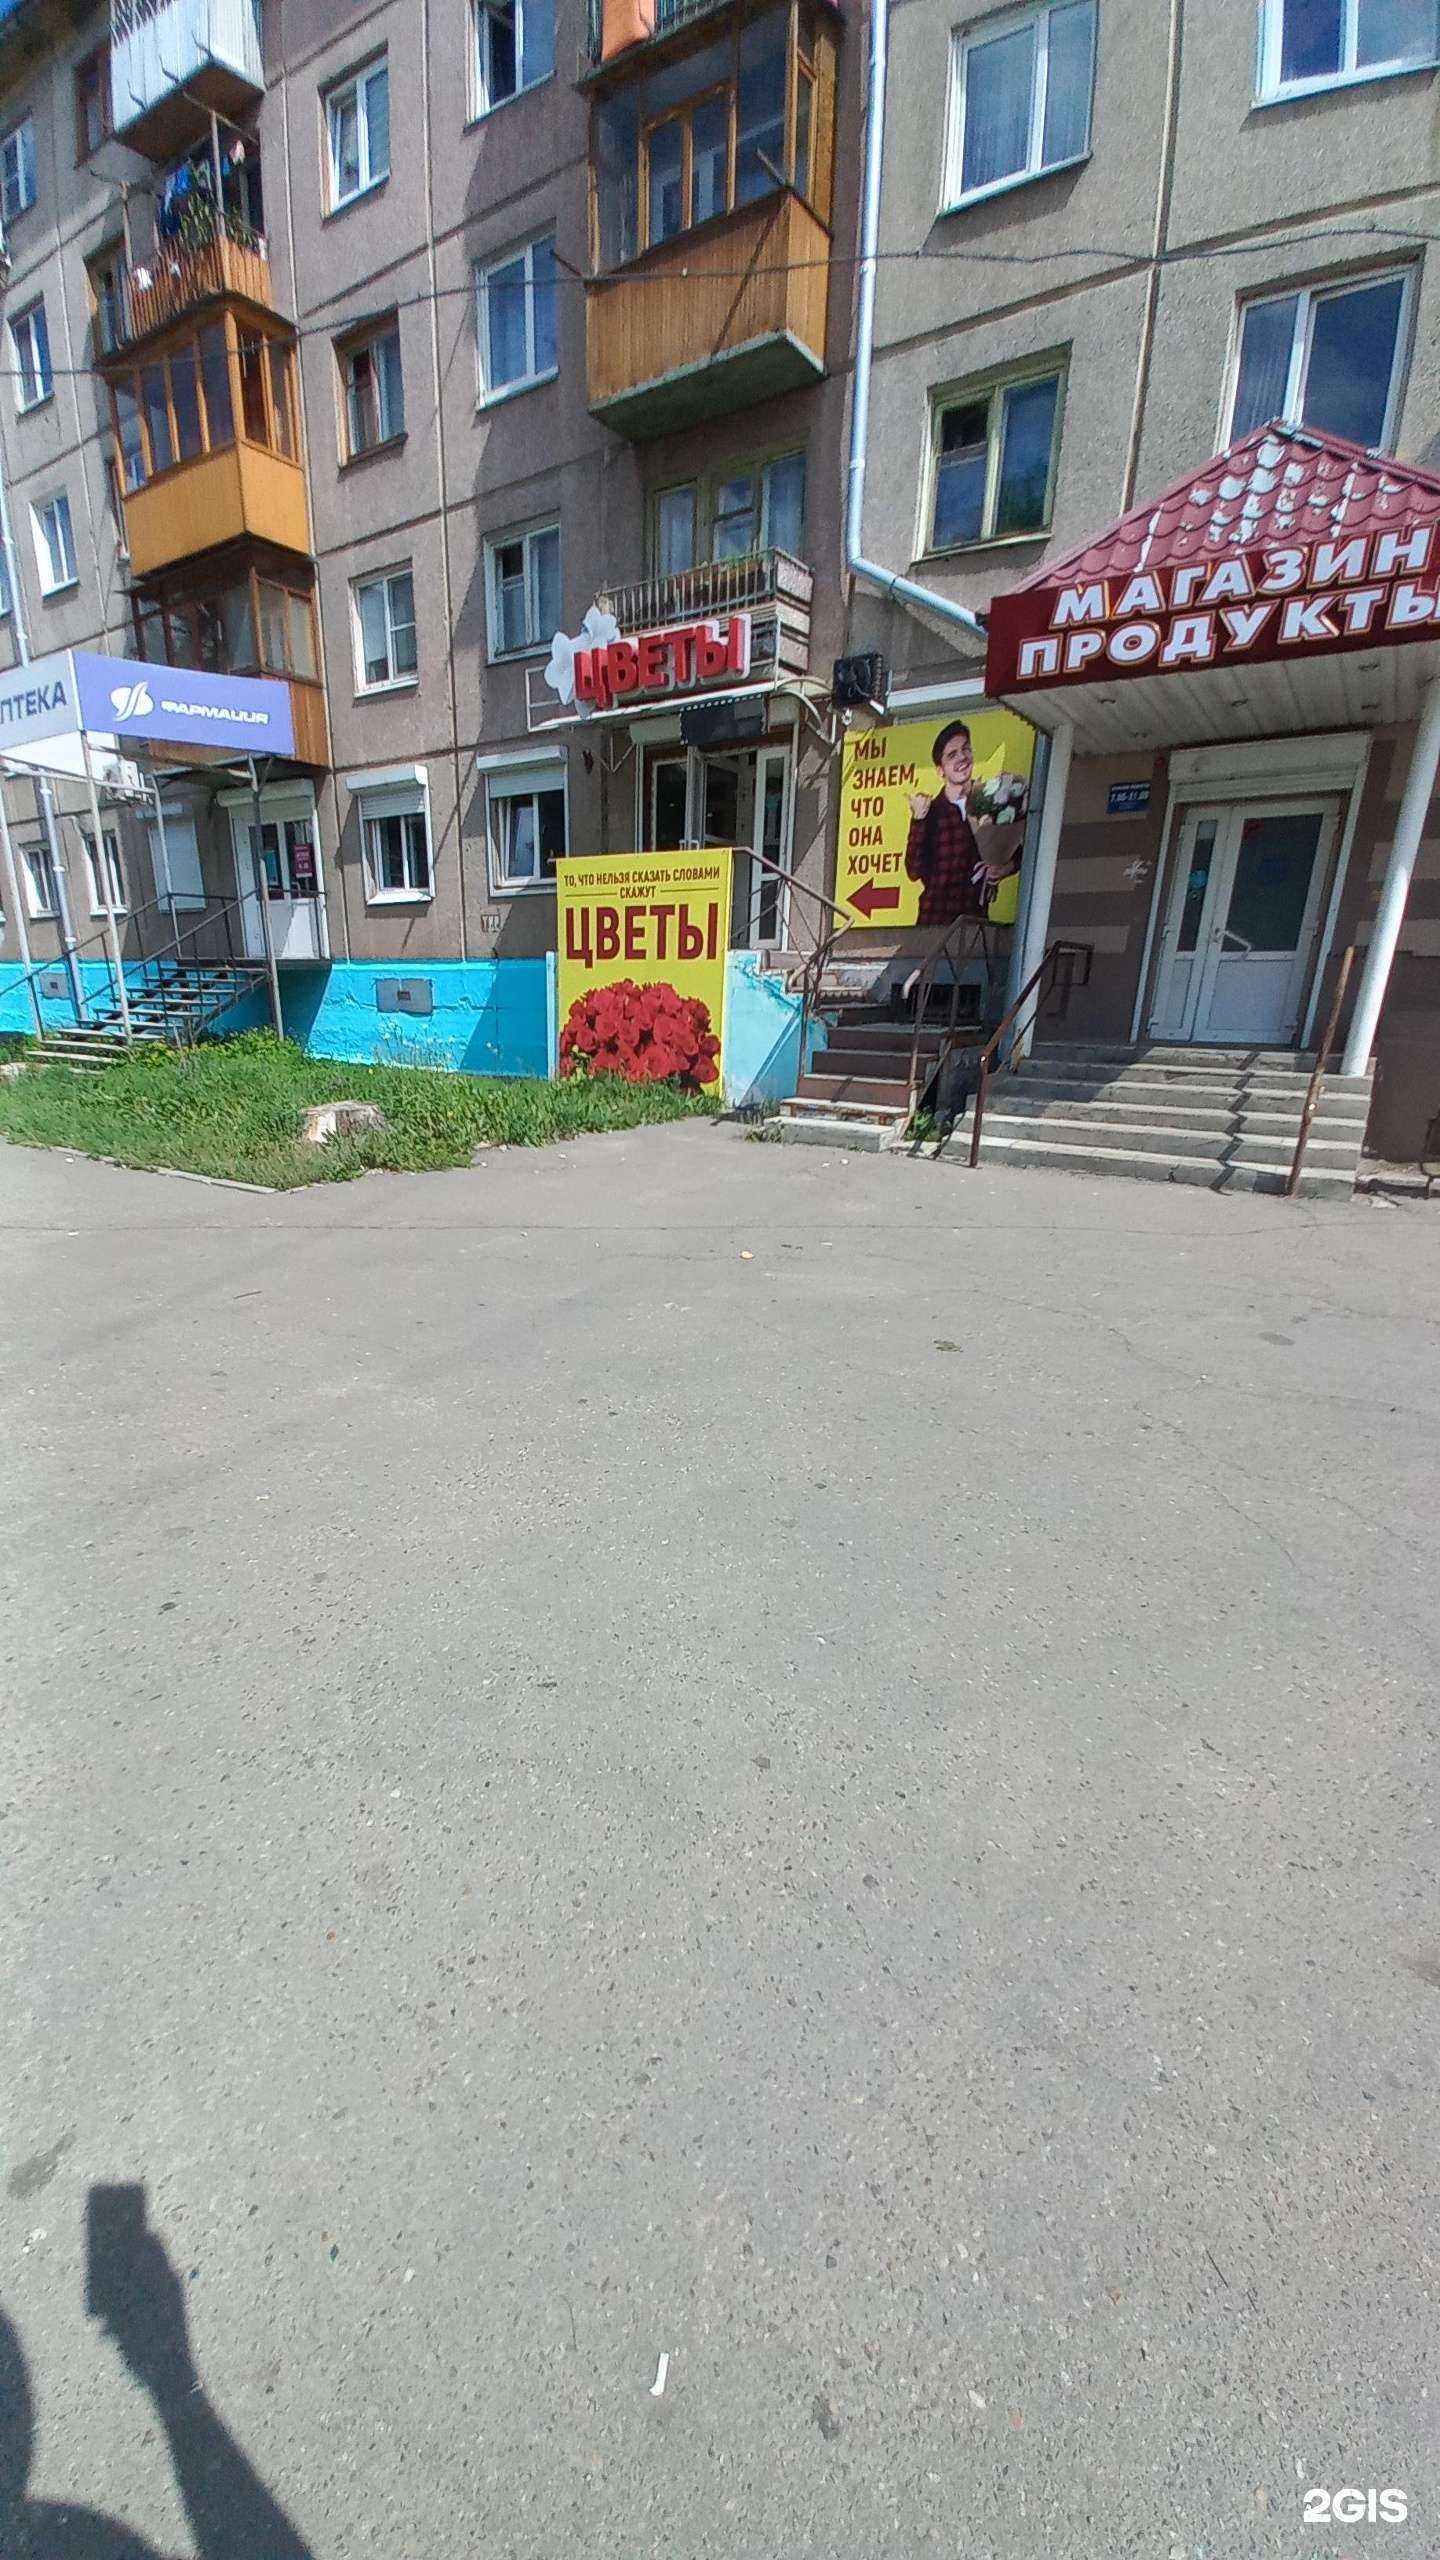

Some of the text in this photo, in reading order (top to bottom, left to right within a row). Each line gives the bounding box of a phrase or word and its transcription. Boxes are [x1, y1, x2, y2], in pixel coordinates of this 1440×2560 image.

[1050, 525, 1432, 629] МАГАЗИН
[1018, 575, 1440, 678] ПРОДУКТЫ
[574, 615, 747, 708] ЦВЕТЫ
[0, 680, 67, 724] ПТЕКА
[854, 737, 887, 761] МЫ
[852, 763, 919, 790] ЗНАЕМ,
[850, 796, 884, 819] ЧТО
[848, 825, 883, 847] ОНА
[847, 852, 903, 875] ХОЧЕТ
[564, 866, 720, 888] ТО, ЧТО НЕЛЬЗЯ СКАЗАТЬ СЛОВАМИ
[620, 886, 657, 899] СКАЖУТ
[565, 902, 719, 968] ЦВЕТЫ
